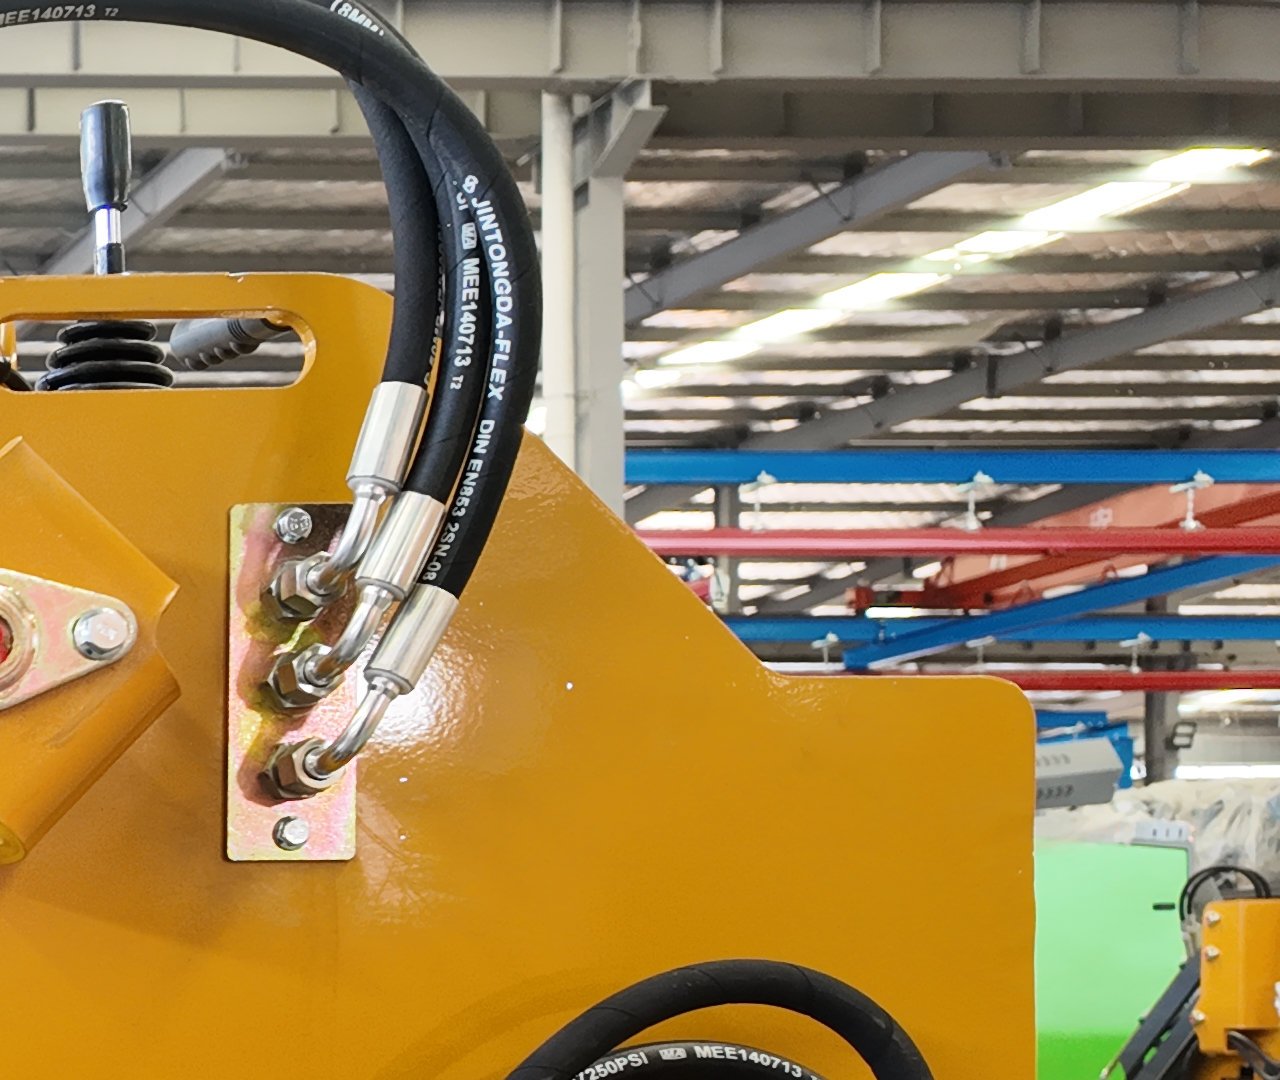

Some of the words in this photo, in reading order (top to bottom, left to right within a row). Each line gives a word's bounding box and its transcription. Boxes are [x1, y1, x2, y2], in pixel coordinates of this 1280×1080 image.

[453, 257, 481, 368] MEE140713
[471, 197, 513, 401] JINTONGDA-FLEX
[450, 374, 464, 390] T2
[473, 419, 496, 455] DIN
[451, 459, 484, 518] EN853
[422, 522, 460, 582] 2SN-08
[693, 1045, 803, 1078] MEE140713
